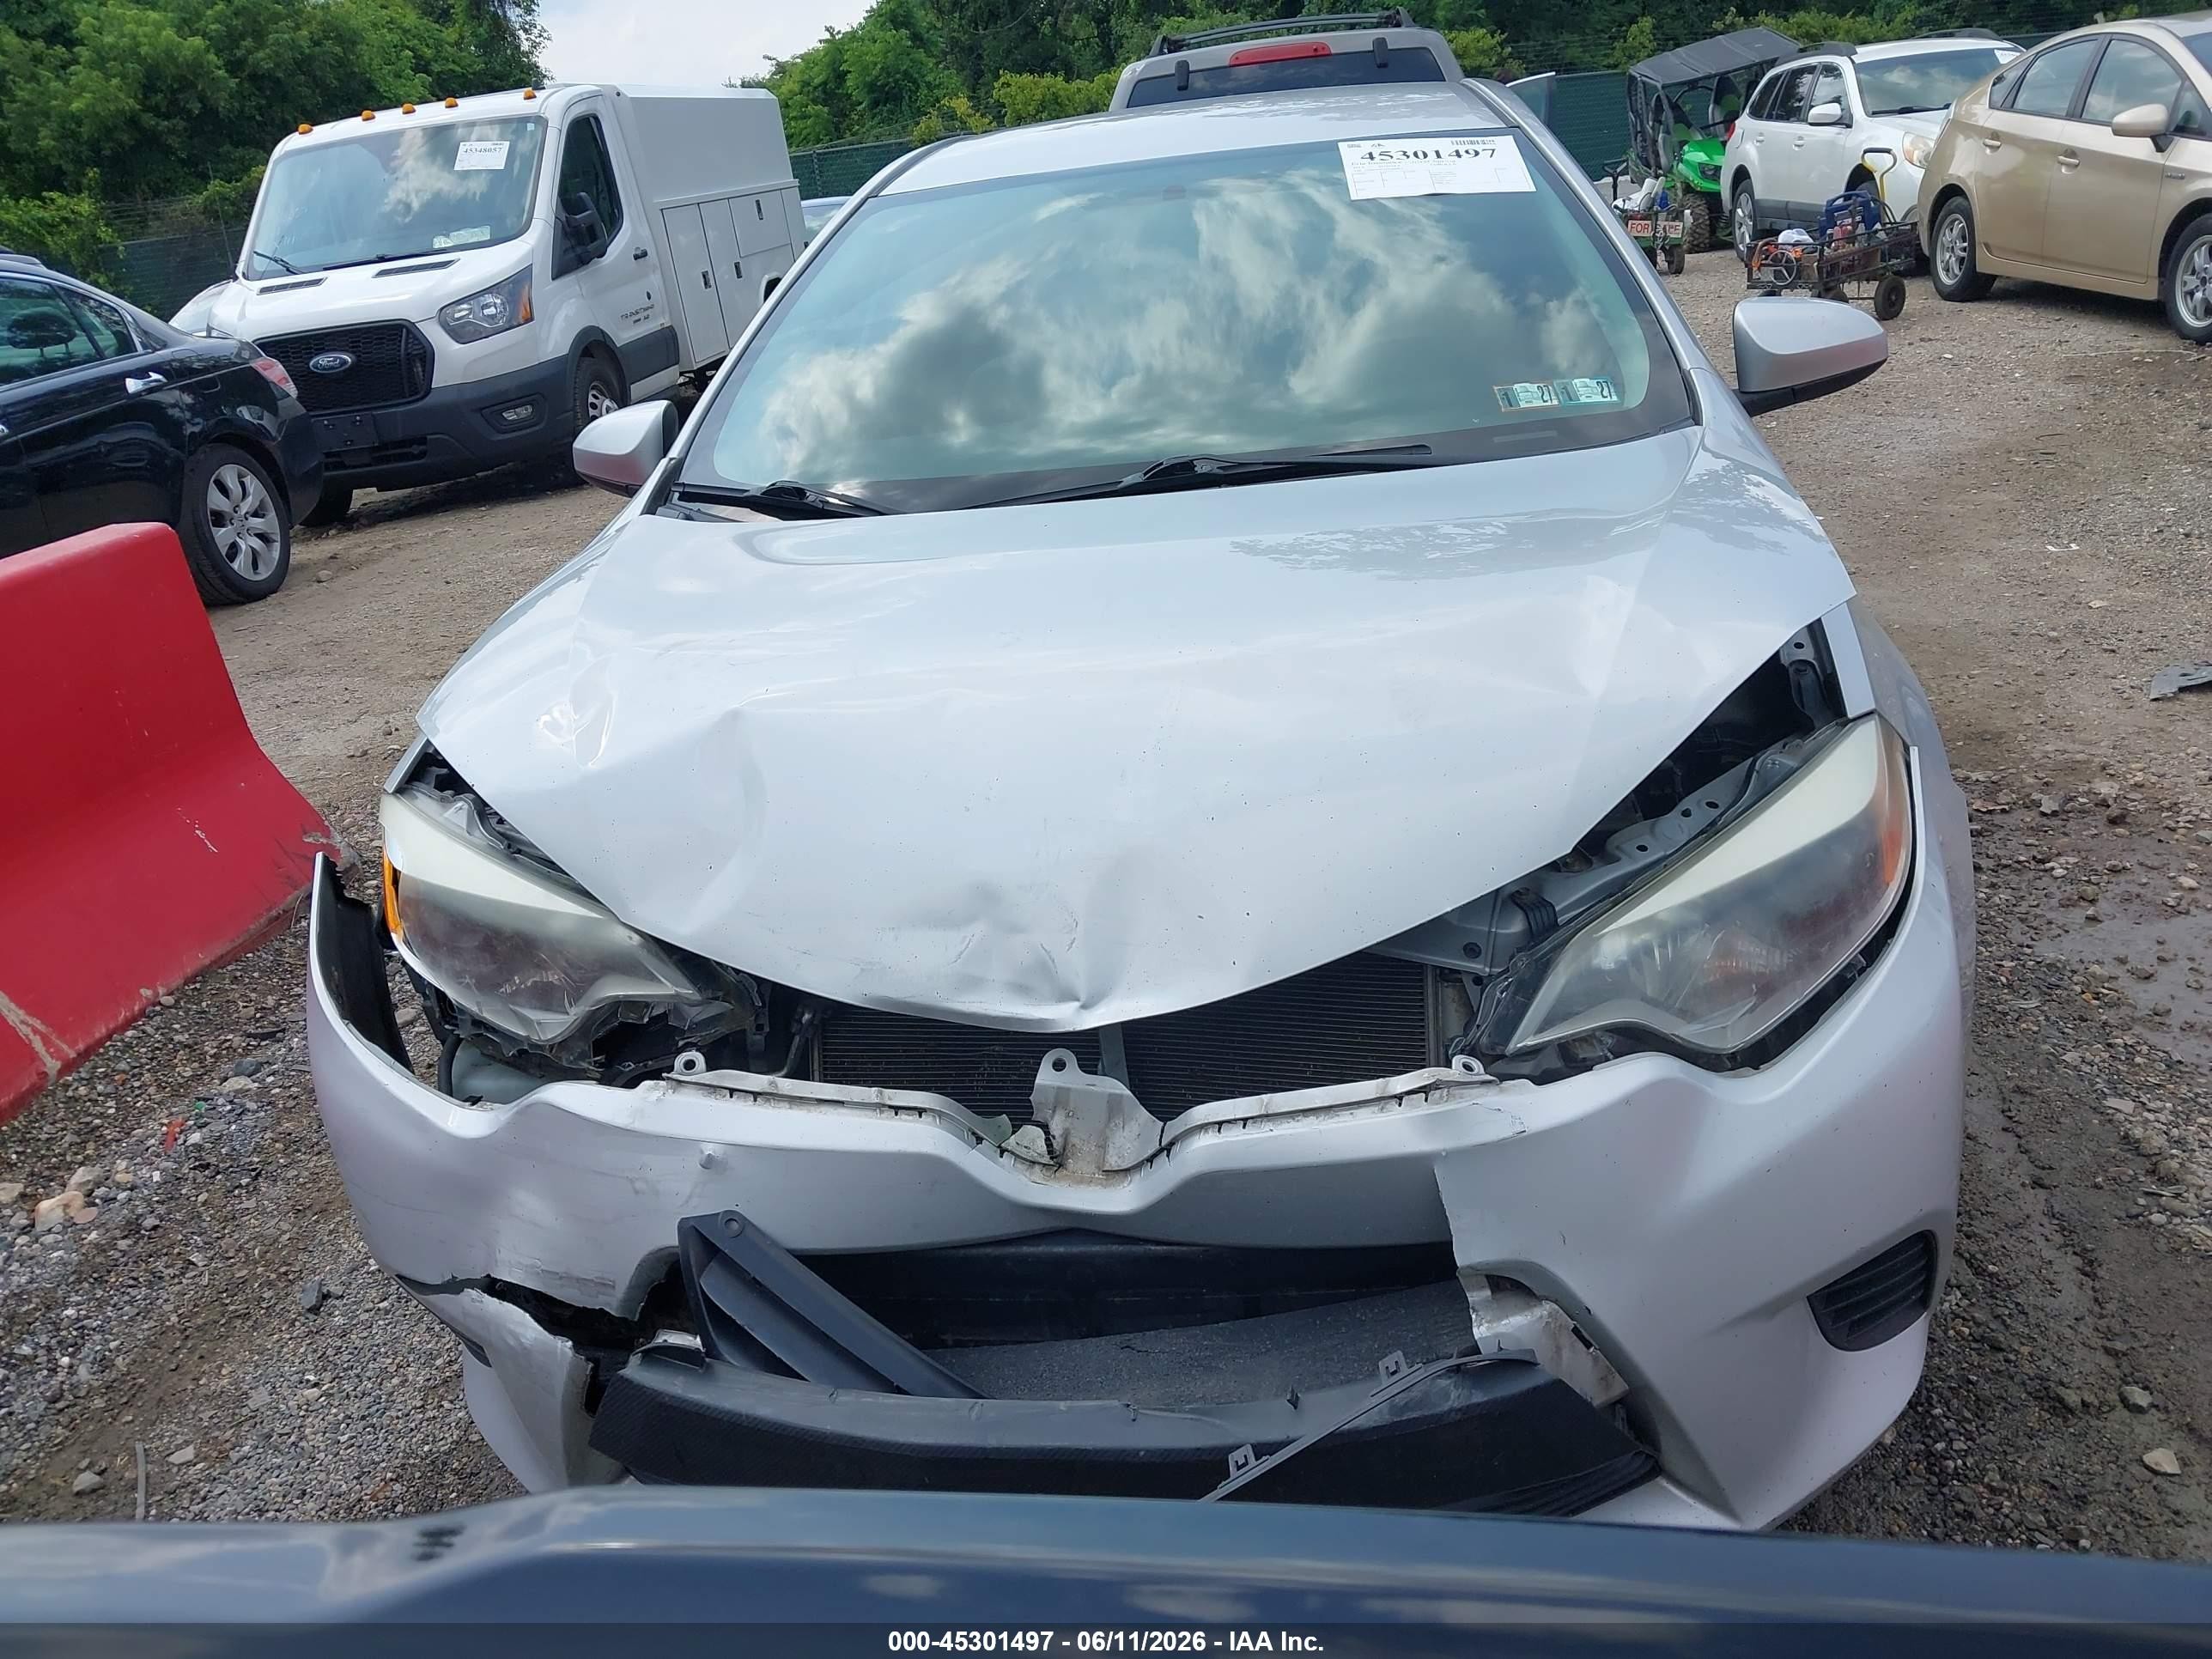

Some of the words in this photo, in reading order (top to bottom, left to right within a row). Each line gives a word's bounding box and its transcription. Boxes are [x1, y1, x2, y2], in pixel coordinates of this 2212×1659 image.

[1360, 148, 1497, 161] 45301497
[1630, 223, 1649, 233] FOR
[318, 357, 340, 369] Ford
[1537, 384, 1553, 404] 27
[1596, 380, 1613, 399] 27
